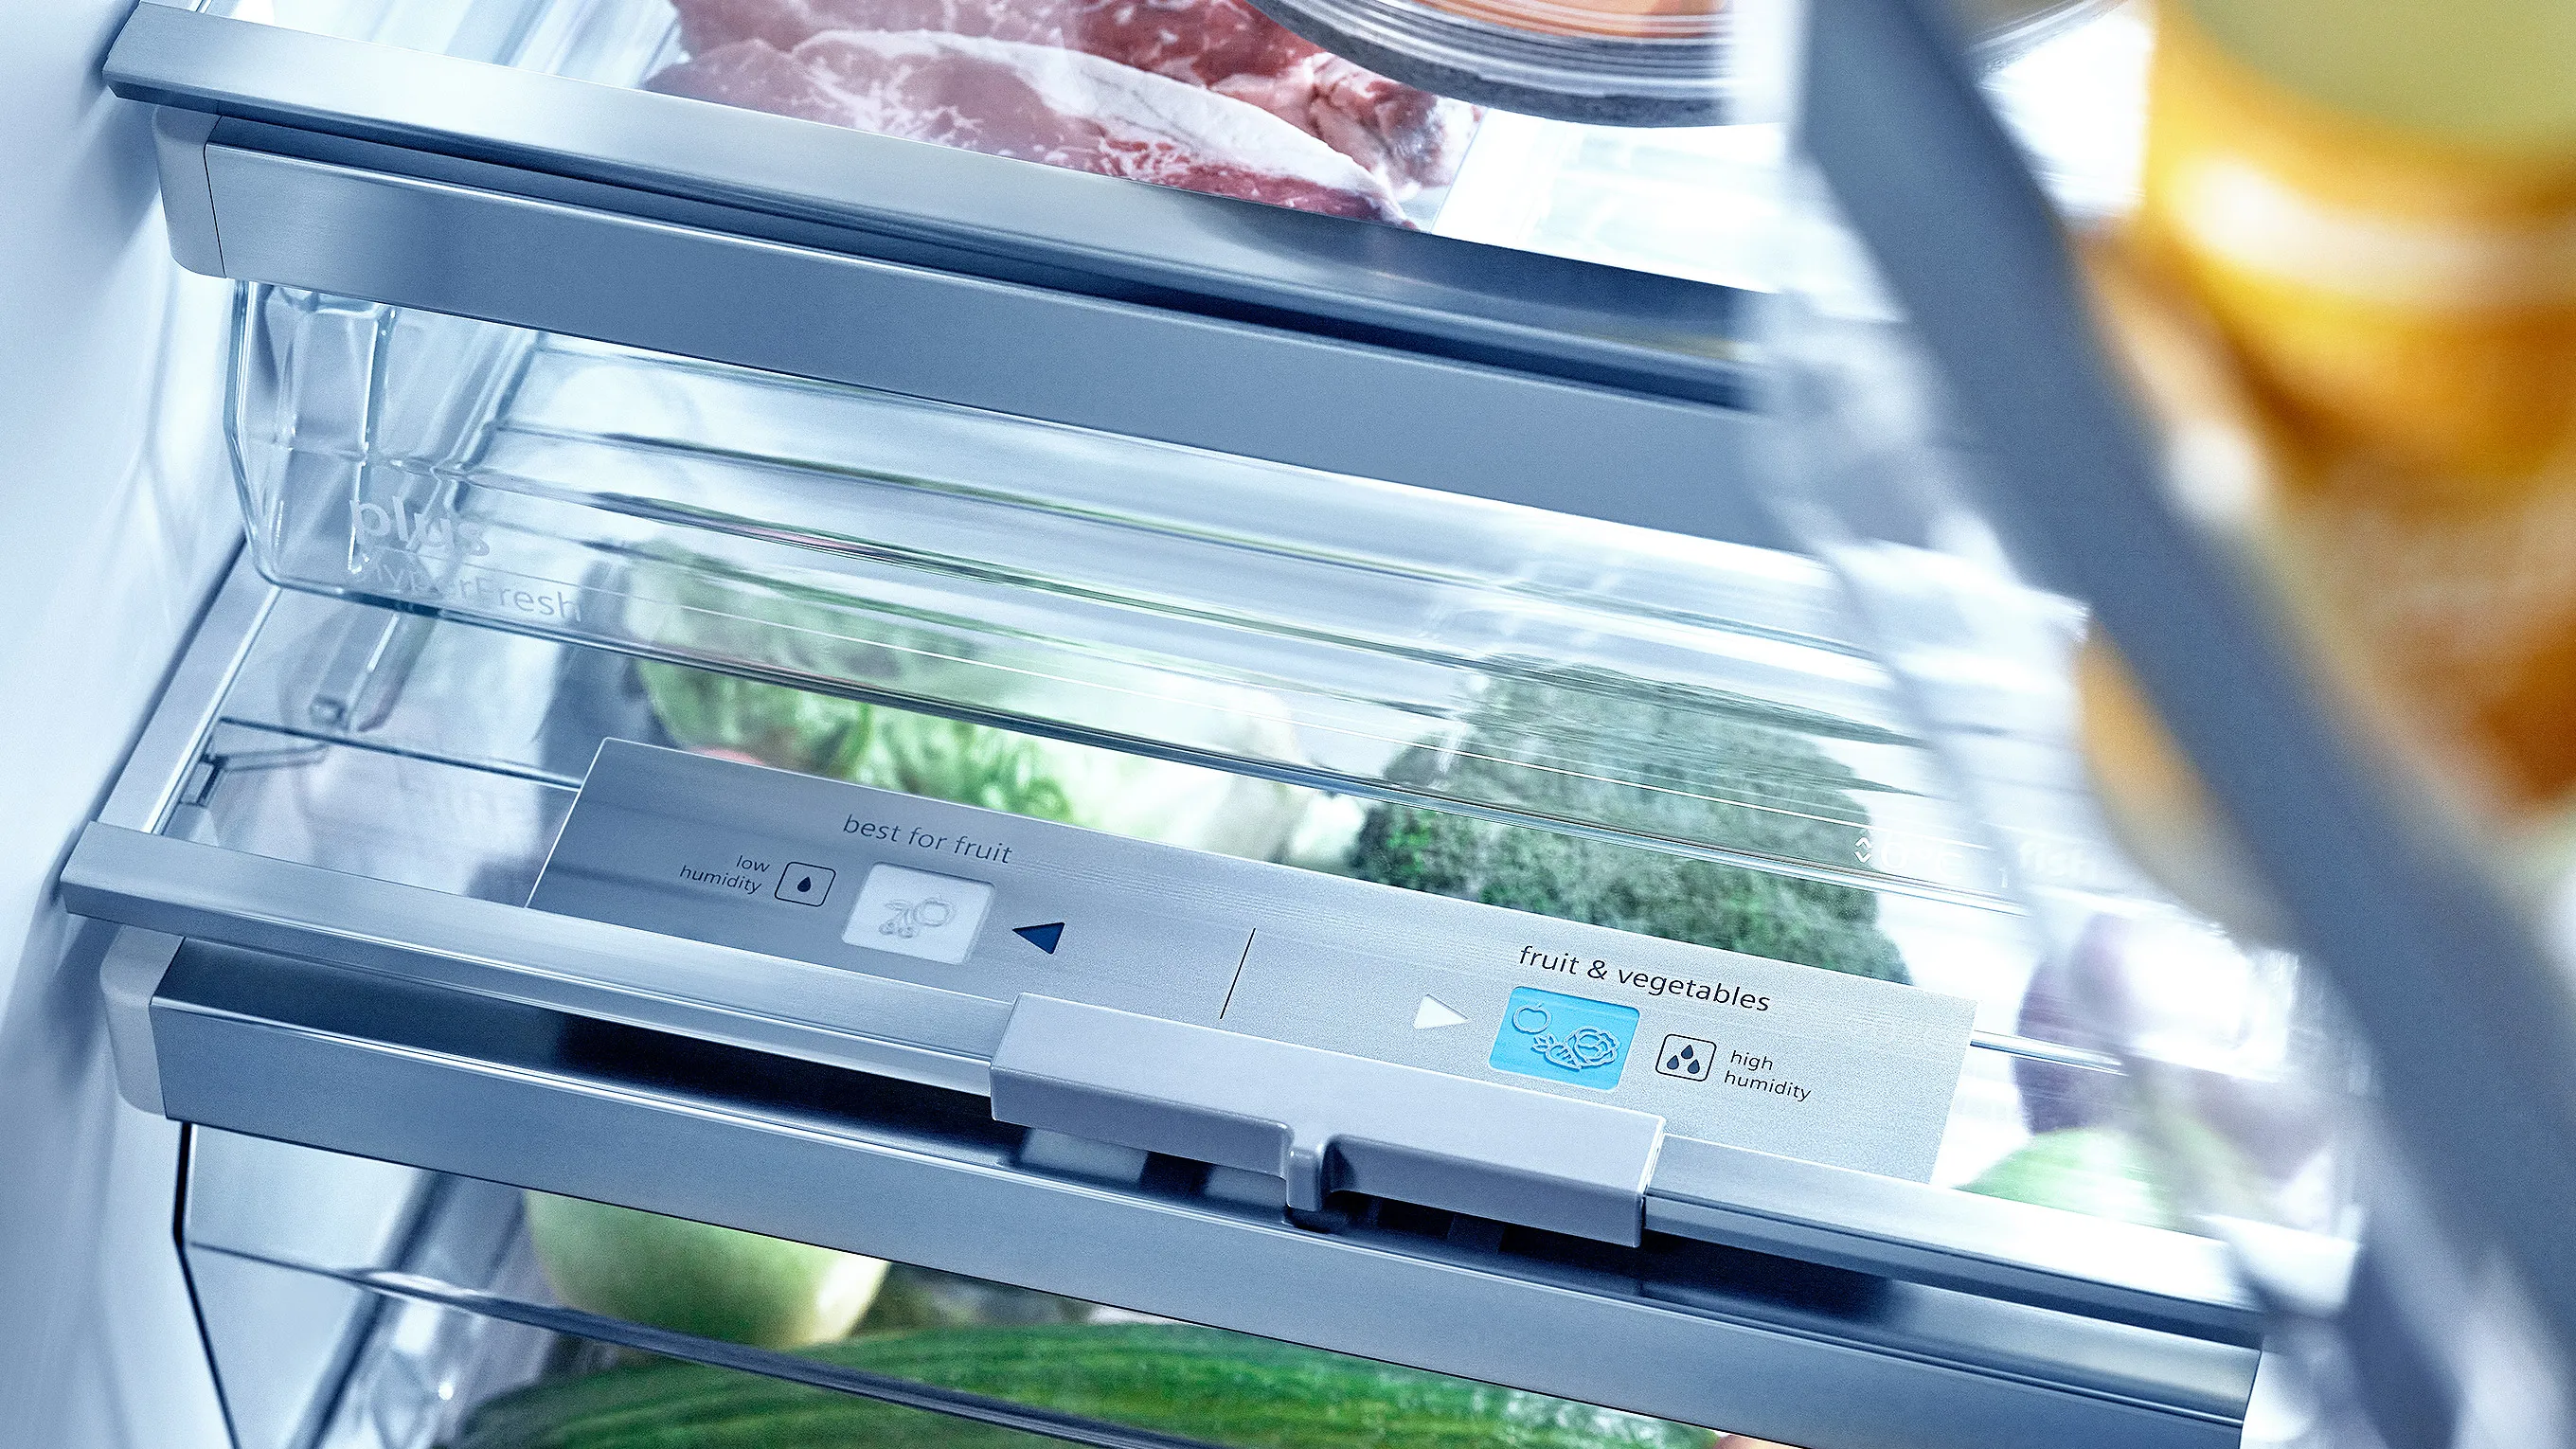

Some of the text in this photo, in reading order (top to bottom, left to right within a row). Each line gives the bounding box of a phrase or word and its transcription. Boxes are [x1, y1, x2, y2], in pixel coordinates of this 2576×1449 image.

[349, 495, 491, 557] plus
[360, 553, 581, 622] yprFresh
[842, 813, 1013, 865] best for fruit
[679, 865, 763, 895] humidity
[736, 855, 771, 873] low
[1519, 945, 1772, 1012] fruit & vegetables
[1729, 1049, 1775, 1072] high
[1724, 1070, 1813, 1103] humidity
